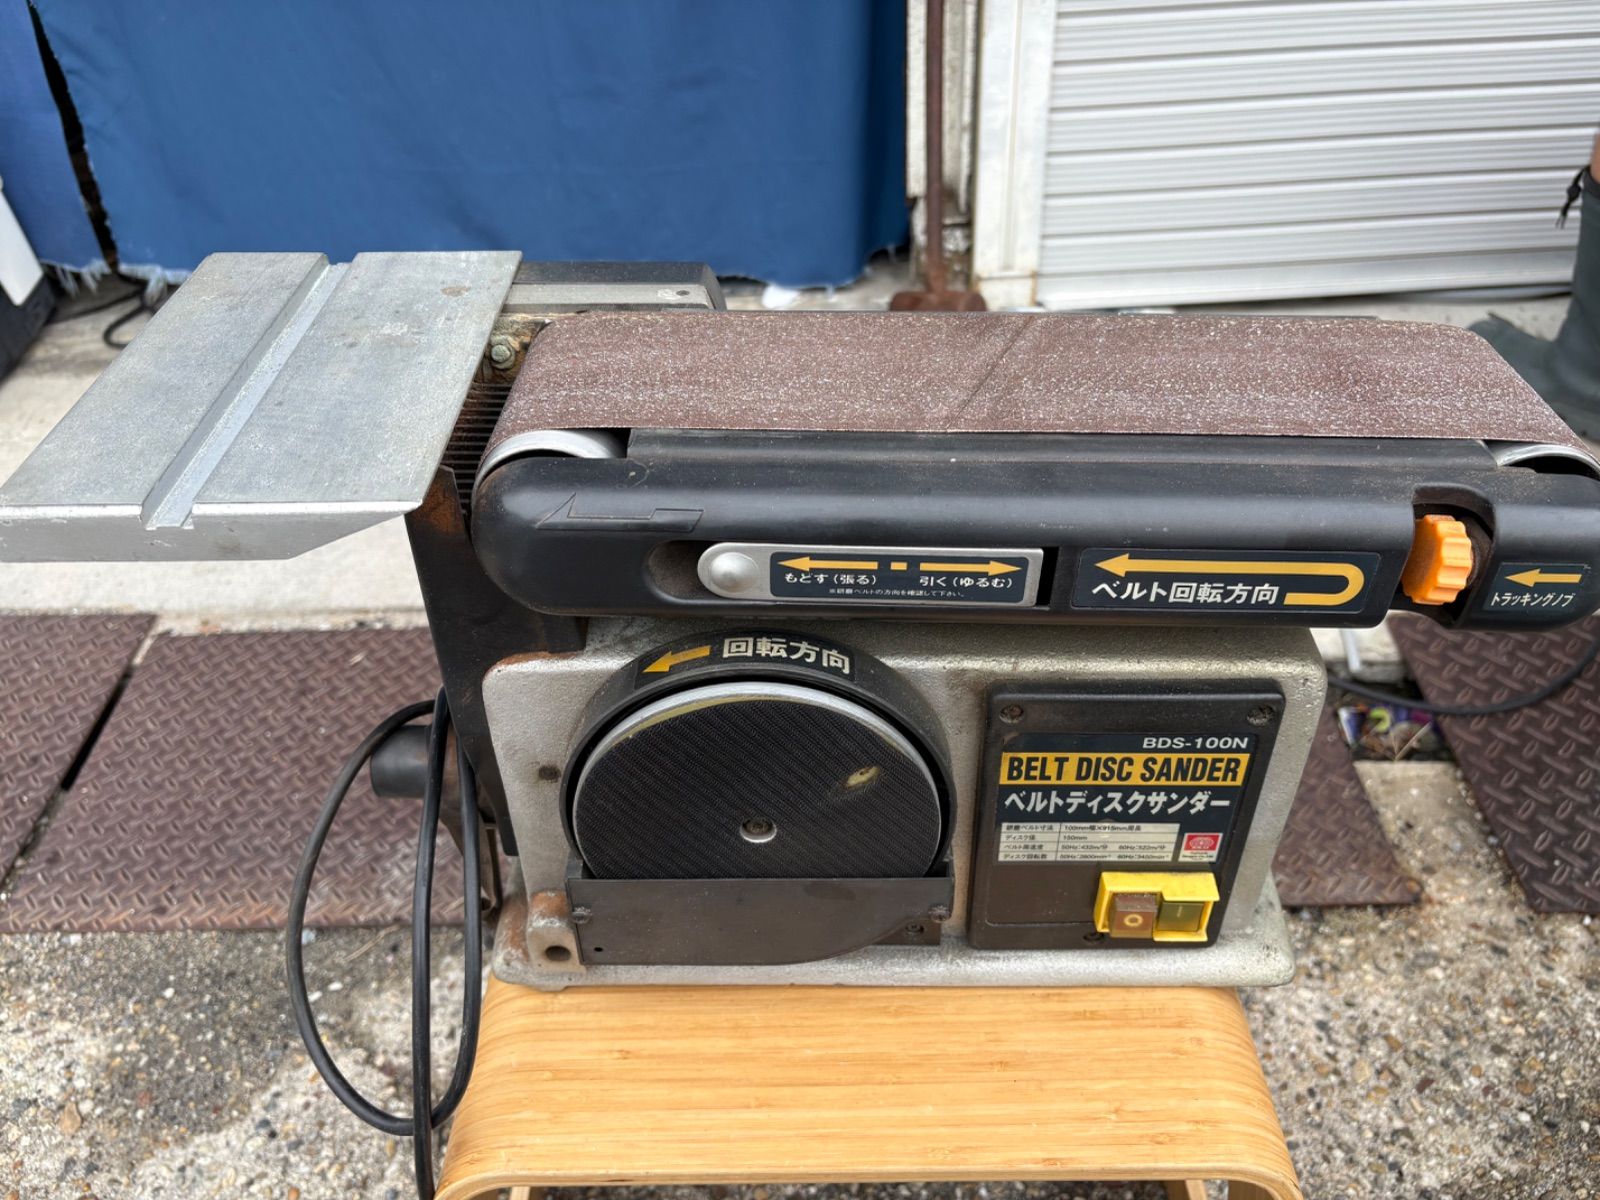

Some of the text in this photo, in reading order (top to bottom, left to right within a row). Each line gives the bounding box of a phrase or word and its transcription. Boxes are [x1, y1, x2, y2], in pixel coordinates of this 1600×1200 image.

[1092, 581, 1280, 605] ベルト回転方向
[1491, 592, 1576, 607] トラッキングノブ
[722, 637, 850, 674] 回転方向
[1142, 737, 1249, 749] BDS-100N
[1007, 757, 1241, 783] BELT DISC SANDER
[1004, 790, 1230, 815] ベルトディスクサンダー
